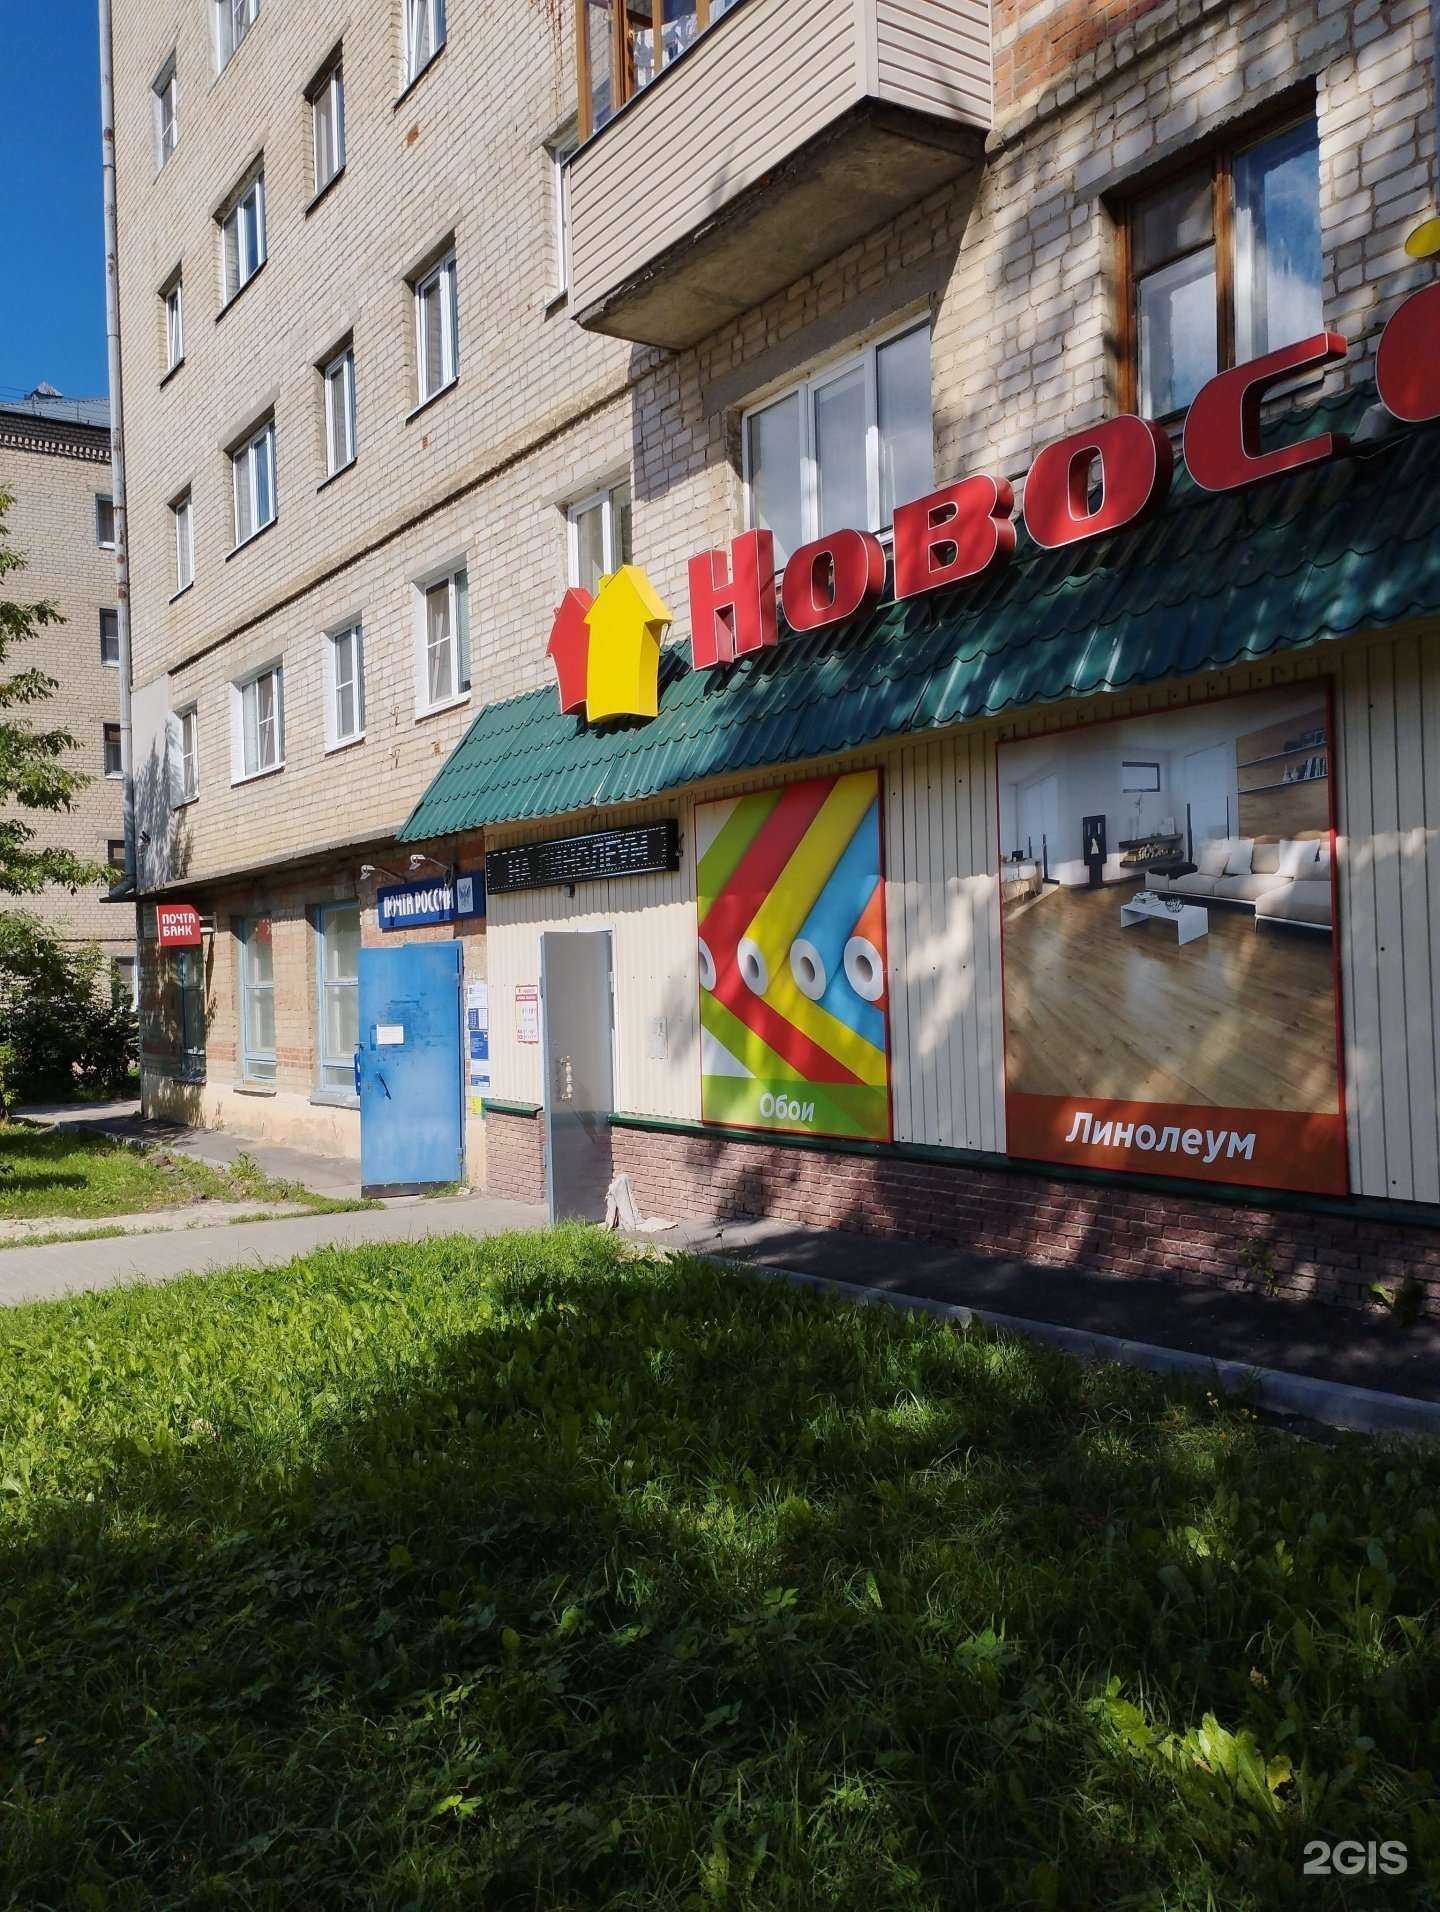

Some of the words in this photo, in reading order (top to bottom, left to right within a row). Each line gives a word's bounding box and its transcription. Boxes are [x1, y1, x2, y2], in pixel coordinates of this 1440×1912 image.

[384, 893, 414, 918] ПОЧТА
[414, 886, 454, 914] РОССИИ
[162, 912, 196, 925] ПОЧТА
[162, 924, 193, 937] БАНК
[759, 1092, 815, 1122] Обои
[1065, 1111, 1257, 1164] Линолеум
